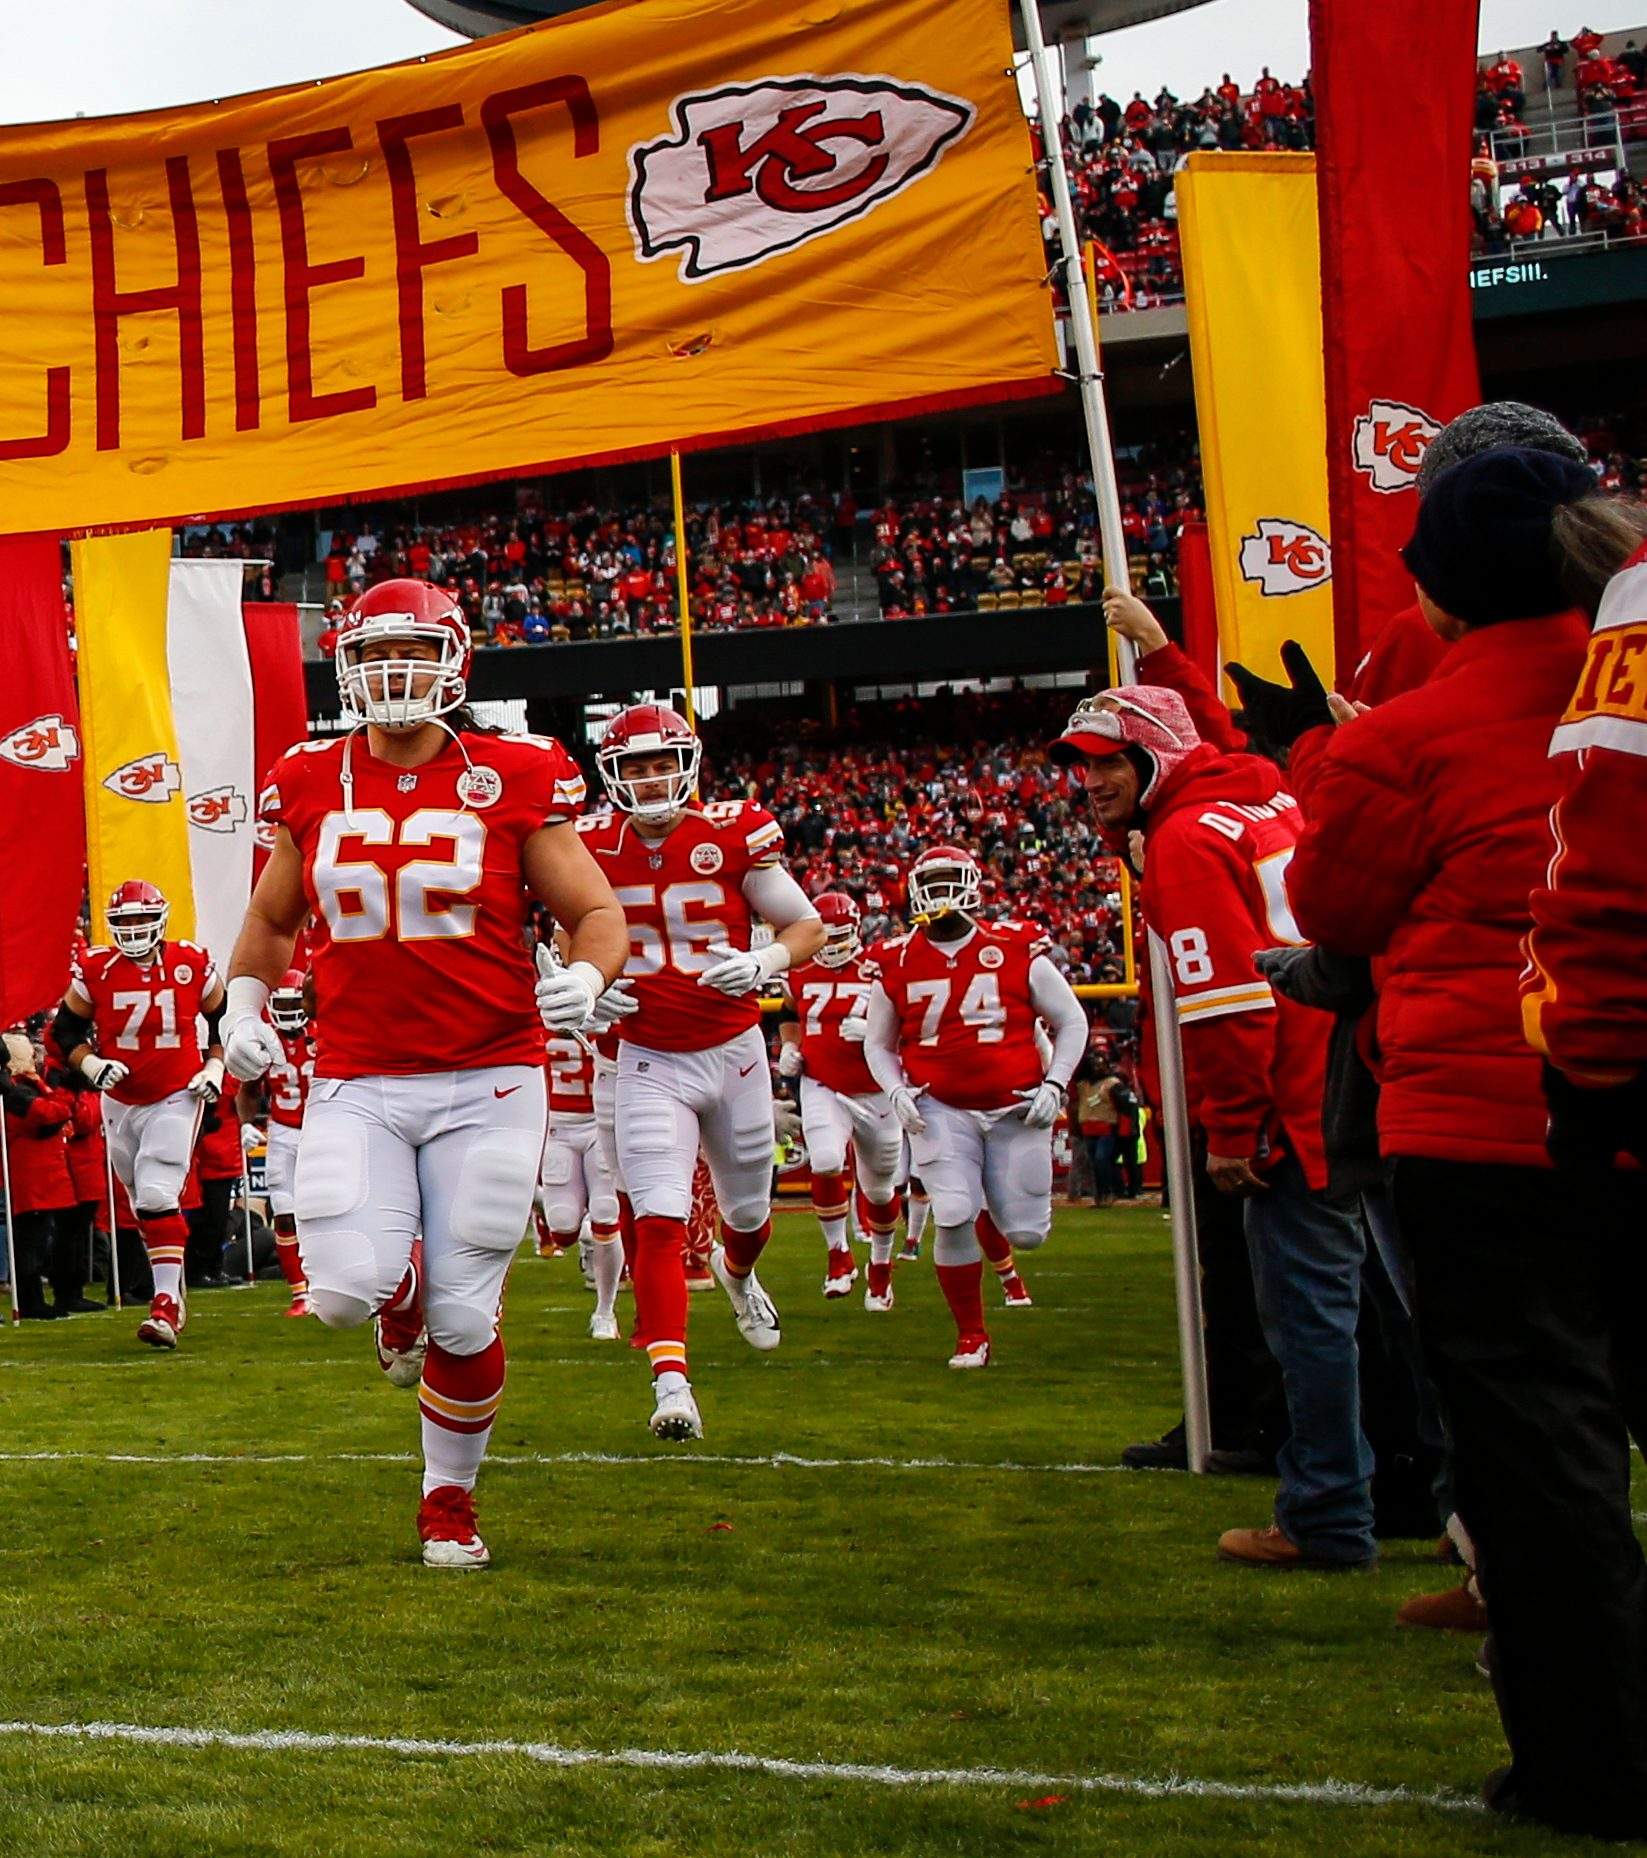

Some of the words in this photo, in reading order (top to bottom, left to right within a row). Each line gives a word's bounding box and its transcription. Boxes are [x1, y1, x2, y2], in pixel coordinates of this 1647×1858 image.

[697, 100, 890, 213] KC
[1373, 421, 1434, 473] KC
[1267, 534, 1325, 578] KC
[1576, 633, 1647, 711] IE
[1198, 811, 1245, 841] D
[312, 807, 488, 942] 62
[611, 880, 731, 976] 56
[1170, 926, 1214, 985] 8
[113, 988, 181, 1050] 71
[802, 982, 872, 1037] 77
[906, 972, 1007, 1046] 74
[545, 1038, 593, 1096] 2
